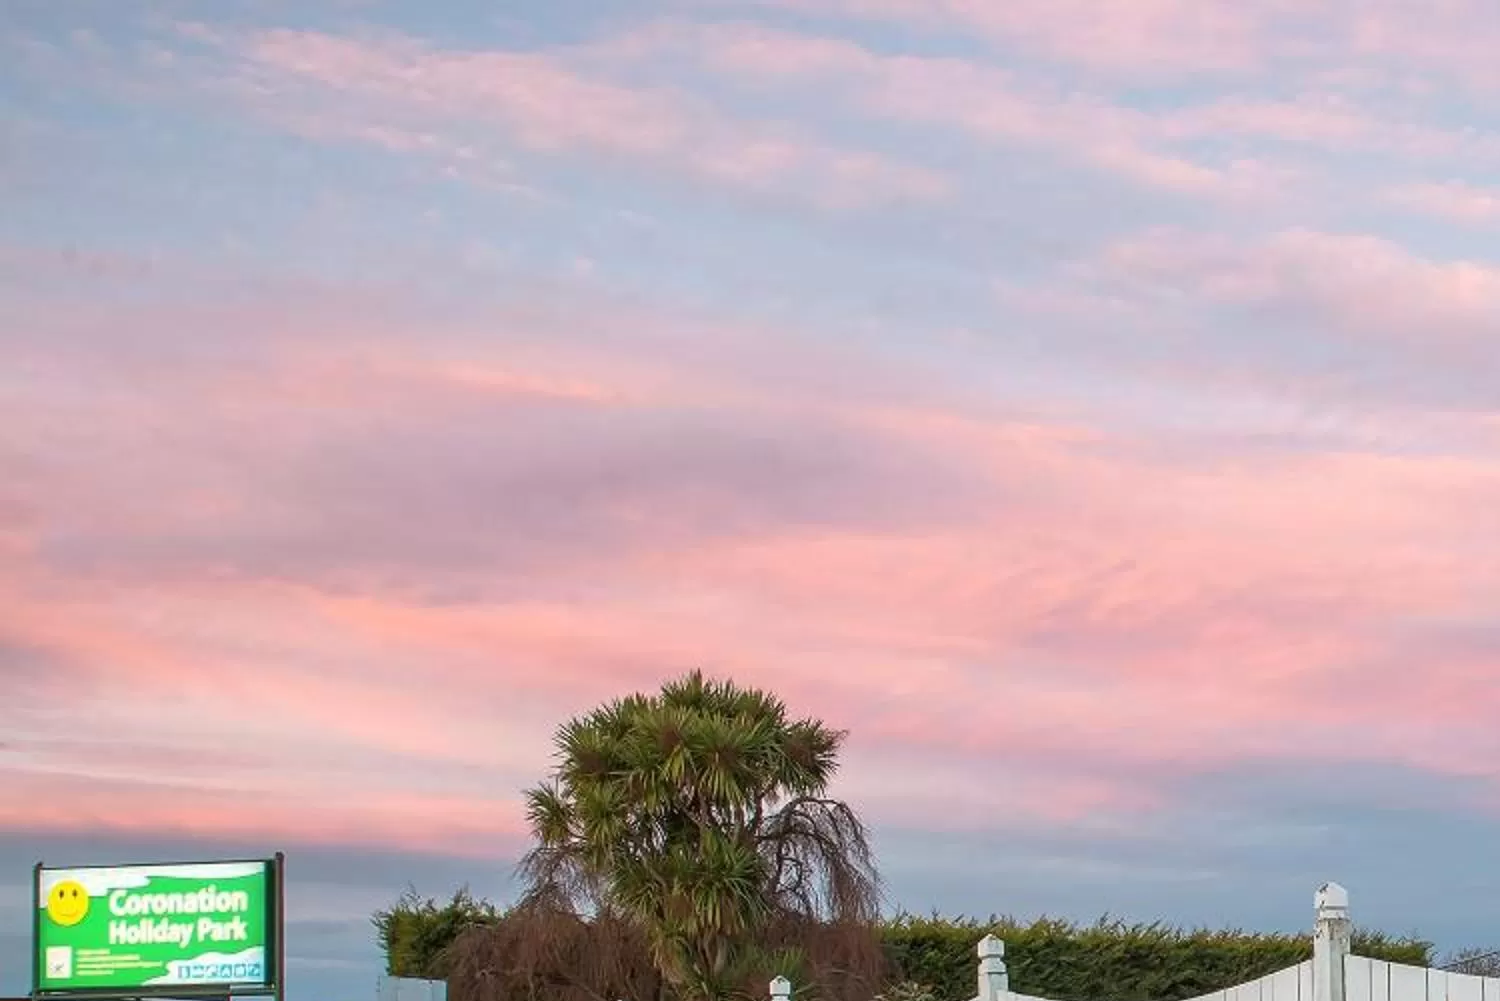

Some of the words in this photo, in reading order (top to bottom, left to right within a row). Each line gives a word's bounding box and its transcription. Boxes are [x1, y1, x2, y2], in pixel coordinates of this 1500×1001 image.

[108, 884, 249, 917] Coronation
[108, 917, 195, 949] Holiday
[197, 916, 248, 942] Park
